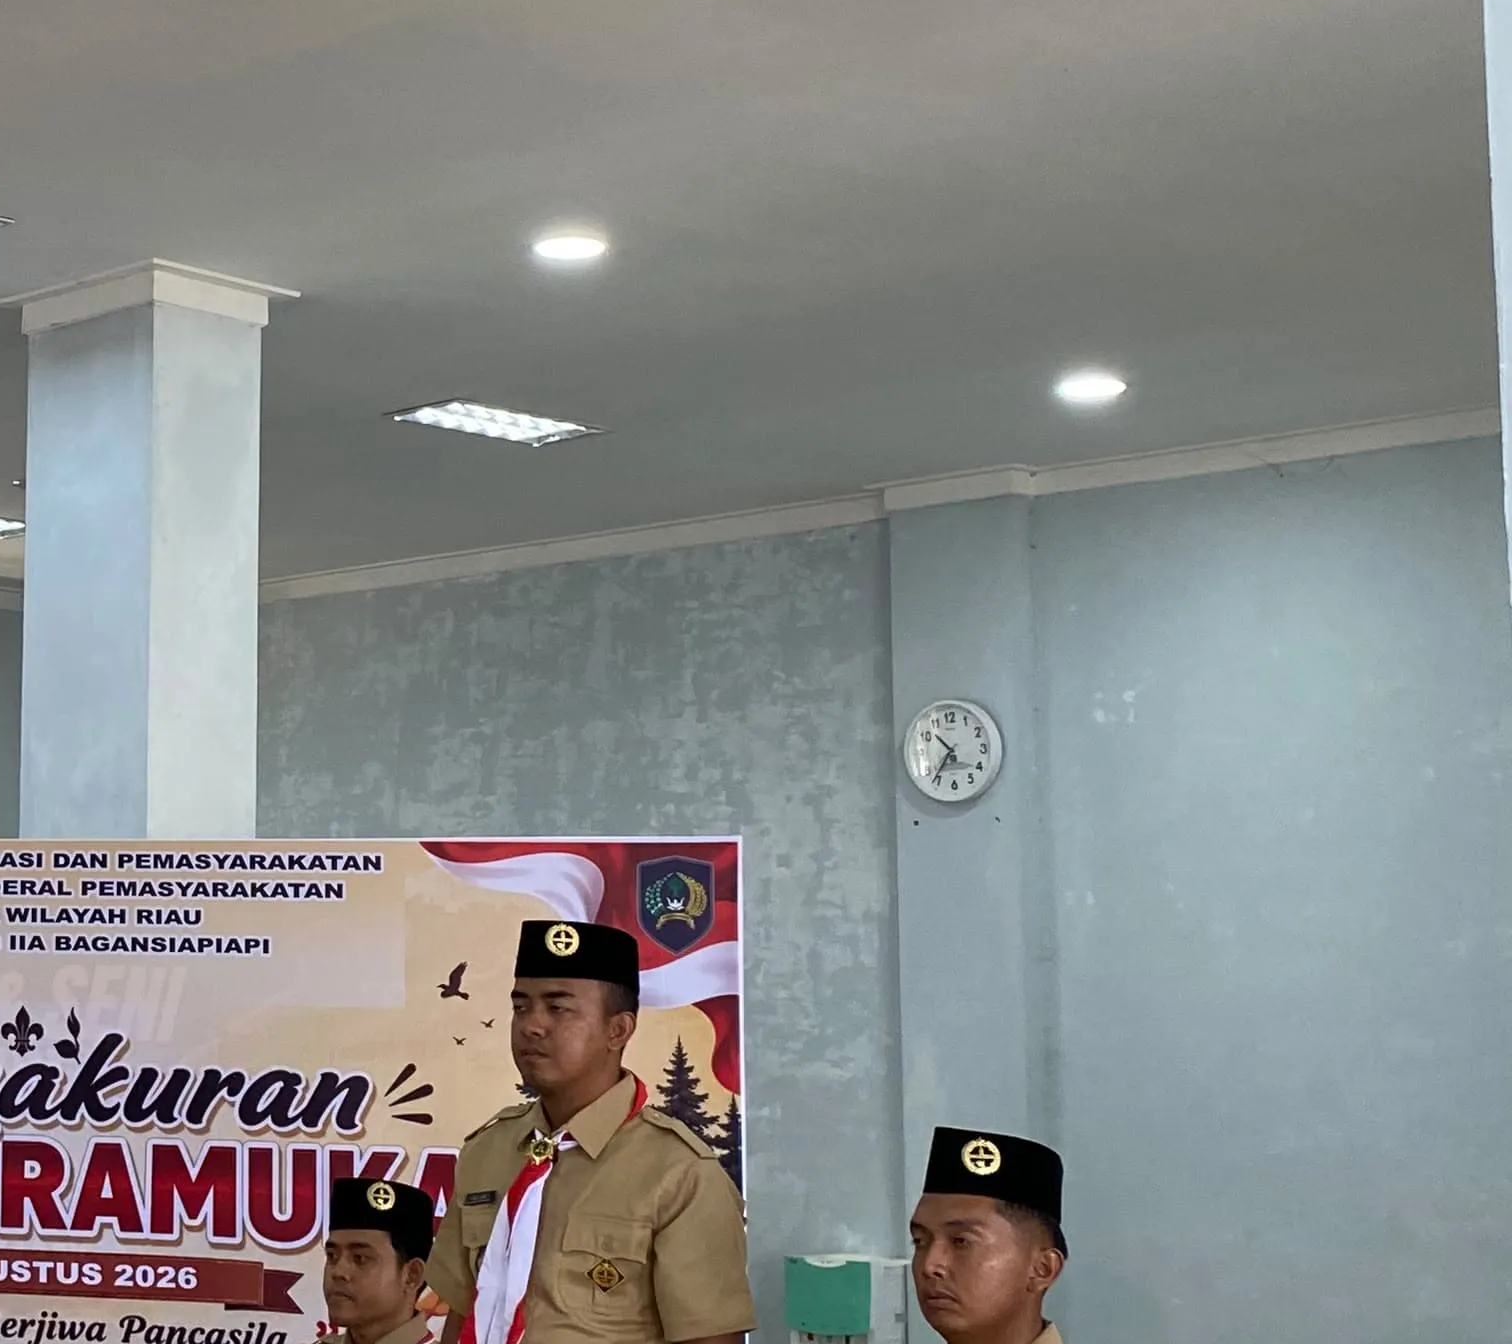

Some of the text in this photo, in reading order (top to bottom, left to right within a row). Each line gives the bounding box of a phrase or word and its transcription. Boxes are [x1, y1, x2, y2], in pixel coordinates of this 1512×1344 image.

[944, 711, 956, 723] 12
[963, 716, 968, 726] 1
[974, 726, 981, 737] 2
[979, 744, 987, 754] 3
[975, 761, 983, 771] 4
[968, 773, 974, 784] 5
[951, 779, 958, 790] 6
[53, 853, 108, 869] DAN
[117, 854, 382, 871] PEMASYARAKATAN
[81, 881, 344, 899] PEMASYARAKATAN
[6, 907, 126, 924] WILAYAH
[137, 909, 202, 925] RIAU
[10, 935, 45, 951] IIA
[55, 936, 271, 954] BAGANSIAPIAPI
[114, 1263, 198, 1289] 2026
